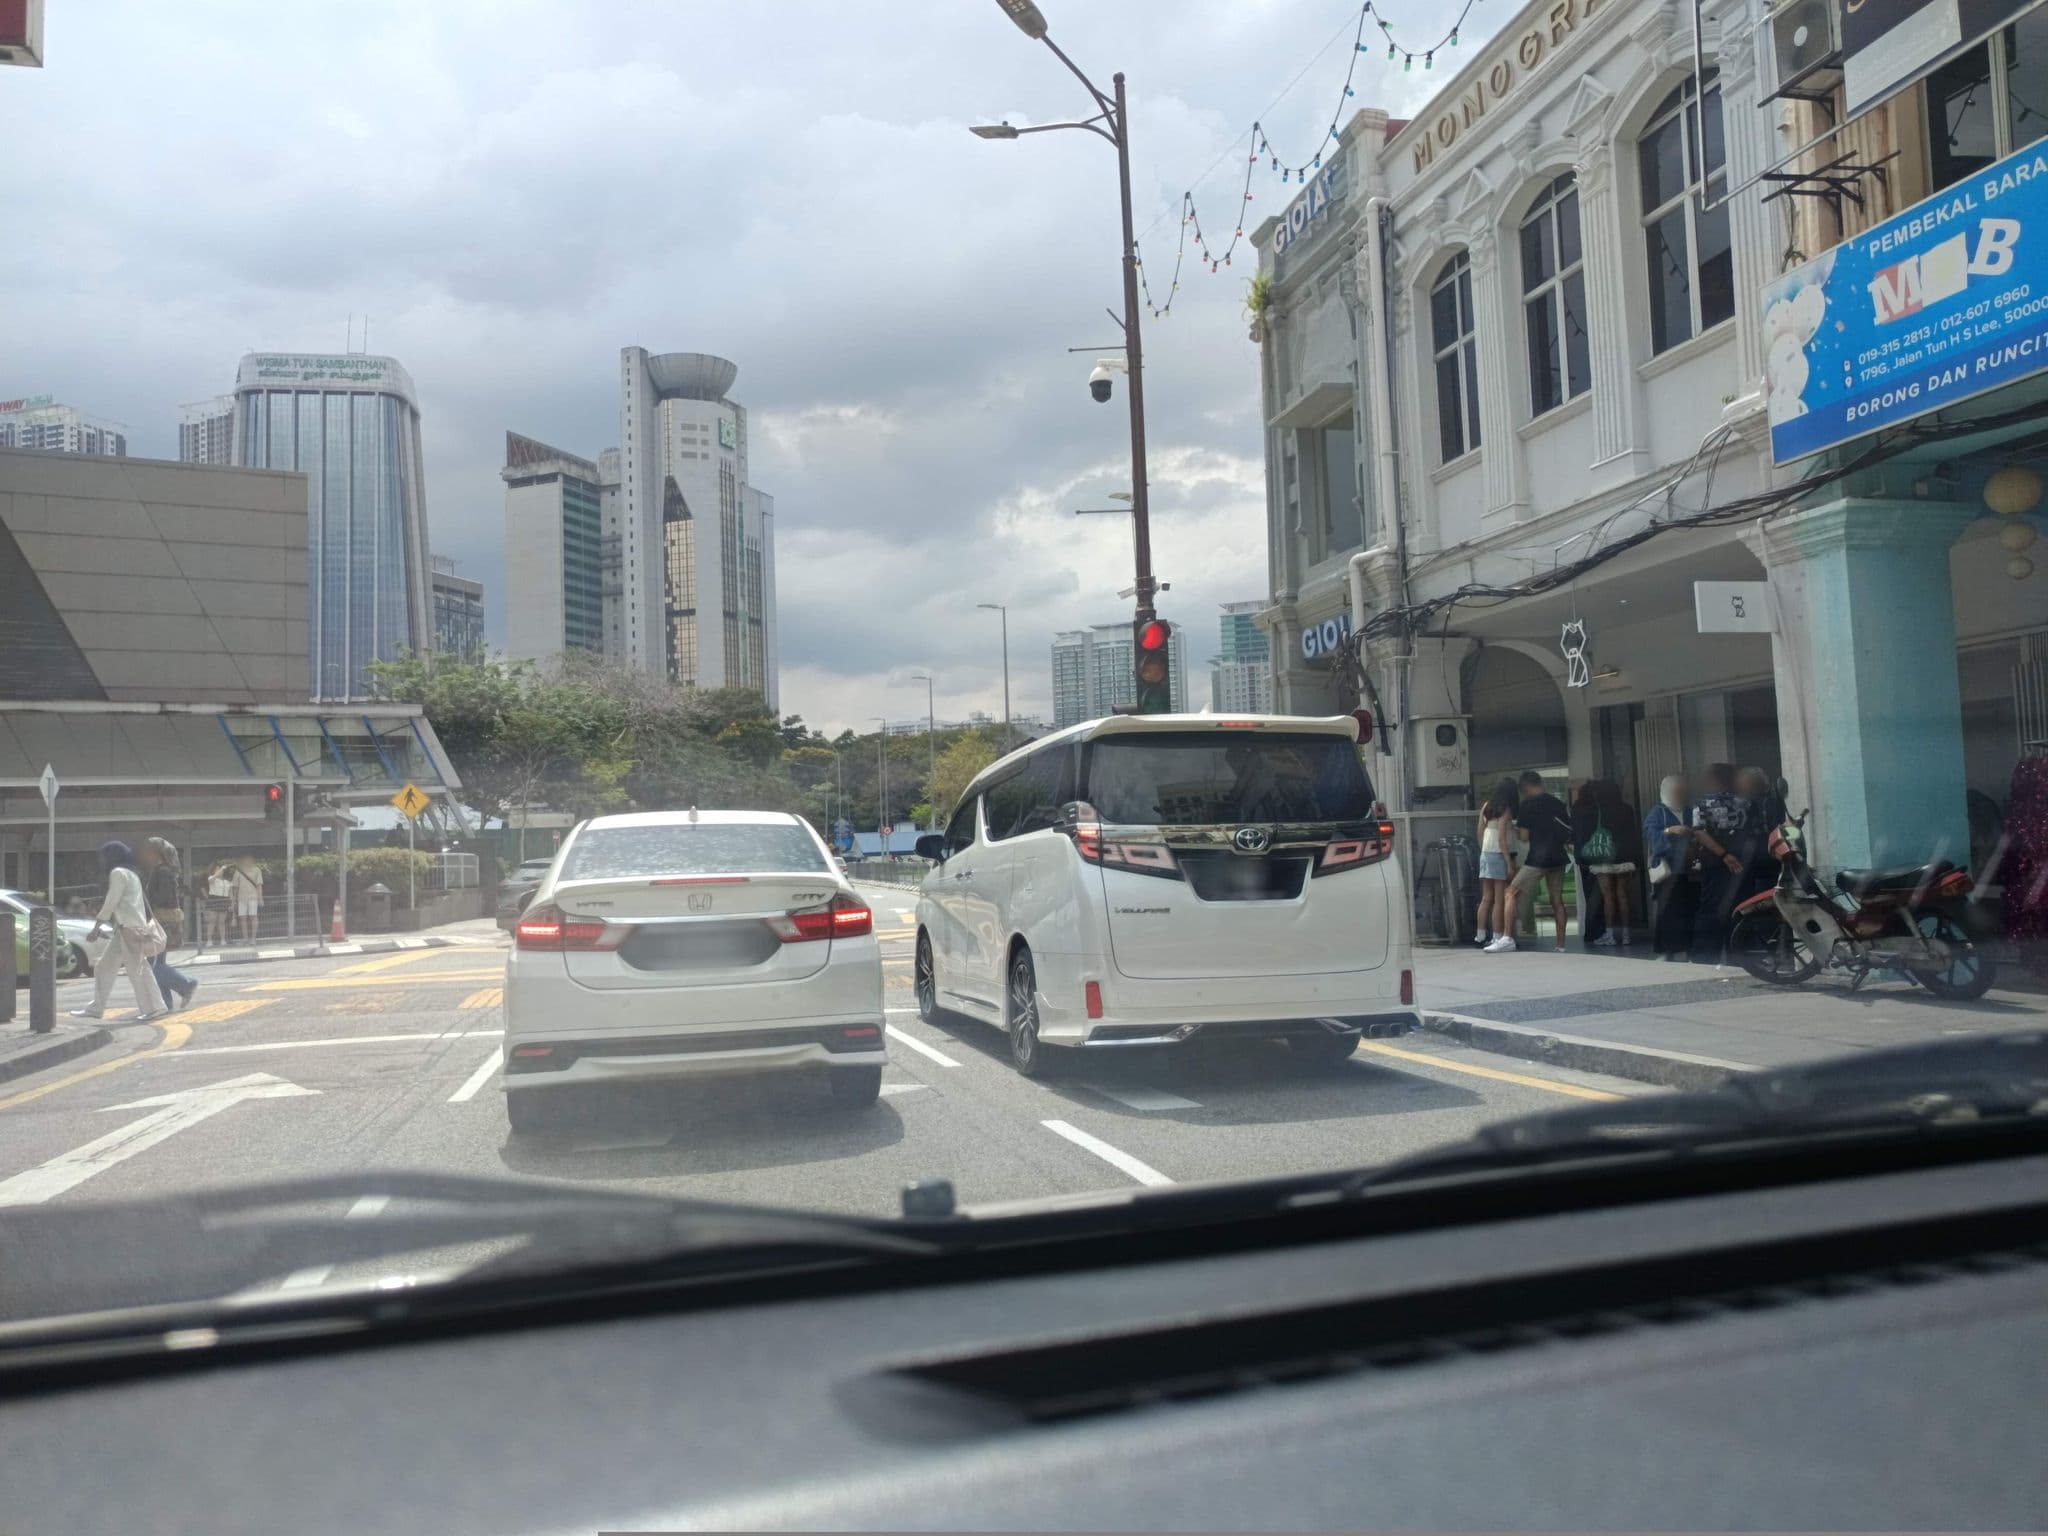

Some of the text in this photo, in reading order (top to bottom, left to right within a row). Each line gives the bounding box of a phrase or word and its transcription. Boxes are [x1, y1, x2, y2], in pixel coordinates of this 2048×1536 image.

[1869, 156, 2048, 259] PEMBEKAL BARA
[255, 357, 386, 371] WISMA TUN SAMBANTHAN
[1858, 339, 1901, 366] 019-315
[1903, 326, 1931, 347] 2813
[1940, 301, 1990, 331] 012-607
[1993, 284, 2030, 309] 6960
[1860, 362, 1890, 382] 179G,
[1893, 349, 1923, 370] Jalan
[1925, 339, 1947, 356] Tun
[1950, 332, 1960, 346] H
[1963, 327, 1972, 341] S
[2004, 296, 2048, 324] 50000
[1846, 382, 1920, 422] BORONG
[1927, 363, 1967, 392] DAN
